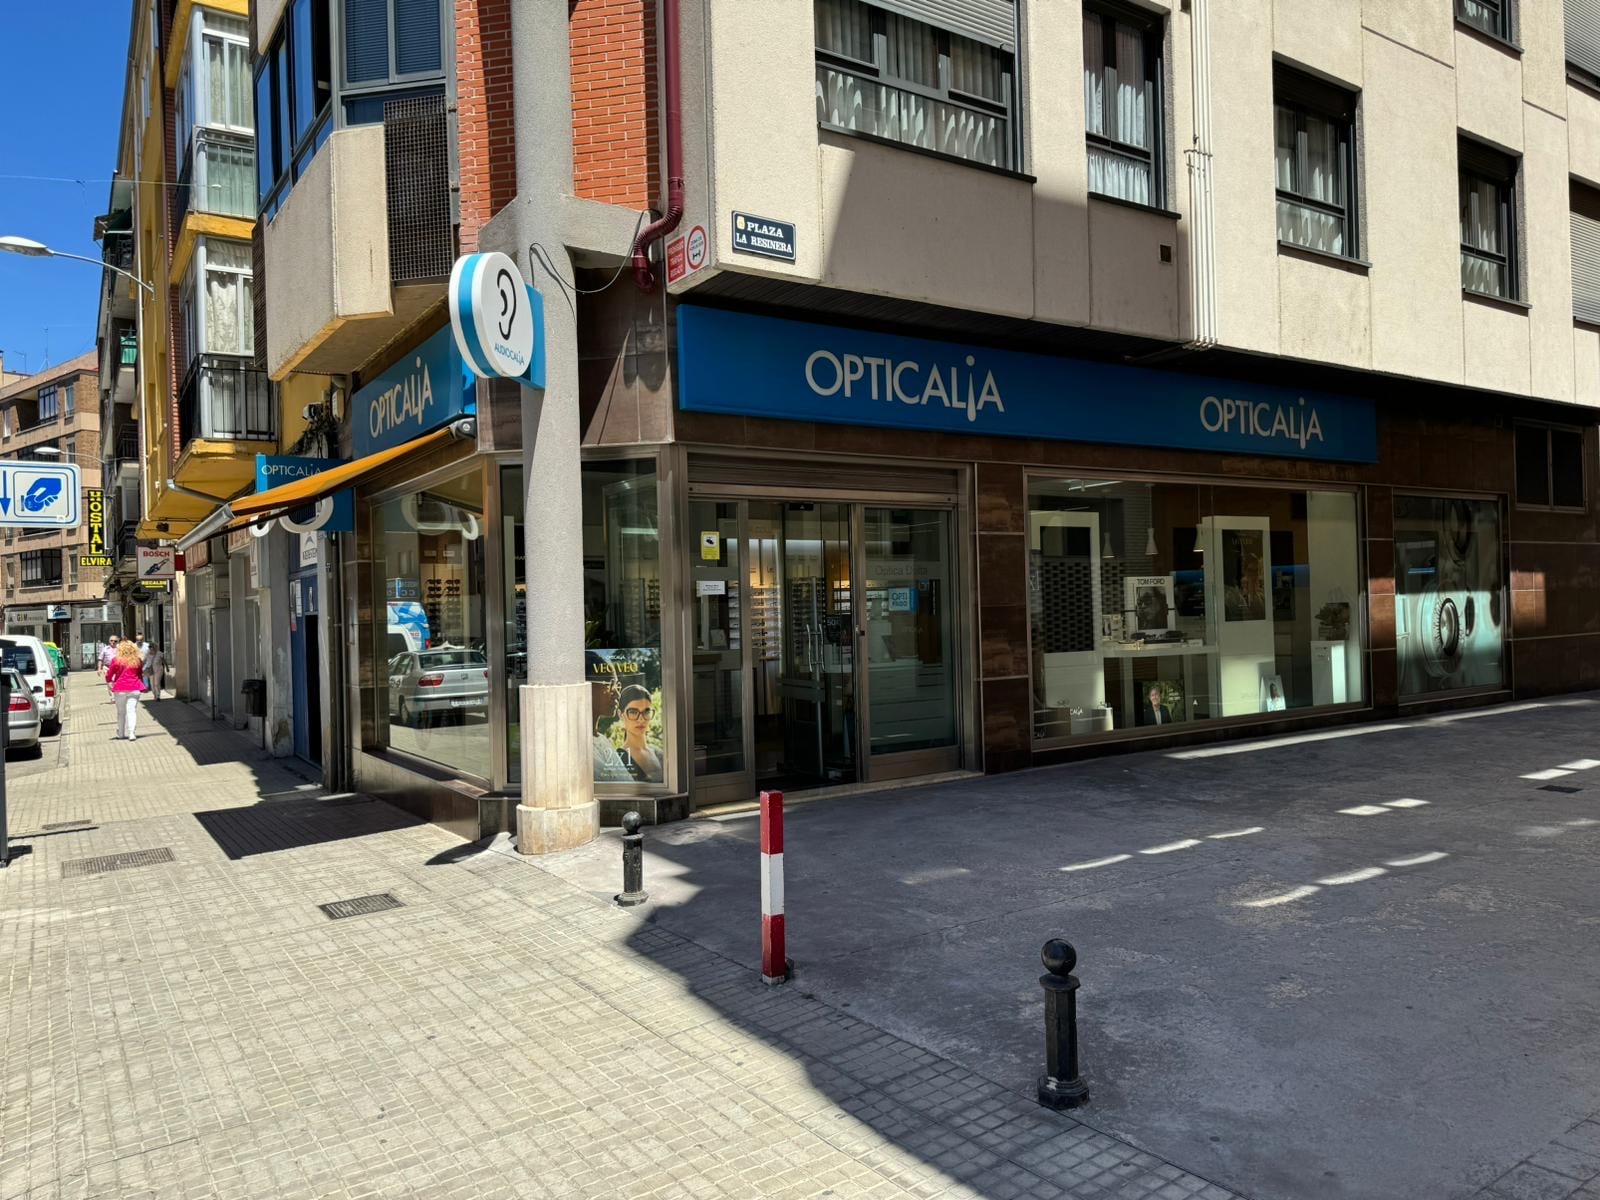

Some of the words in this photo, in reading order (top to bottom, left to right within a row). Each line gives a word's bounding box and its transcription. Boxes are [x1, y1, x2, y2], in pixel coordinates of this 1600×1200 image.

[746, 221, 784, 238] PLAZA
[735, 232, 748, 244] LA
[751, 236, 793, 253] RESINERA
[89, 491, 103, 554] HOSTAL
[81, 557, 113, 566] ELVIRA
